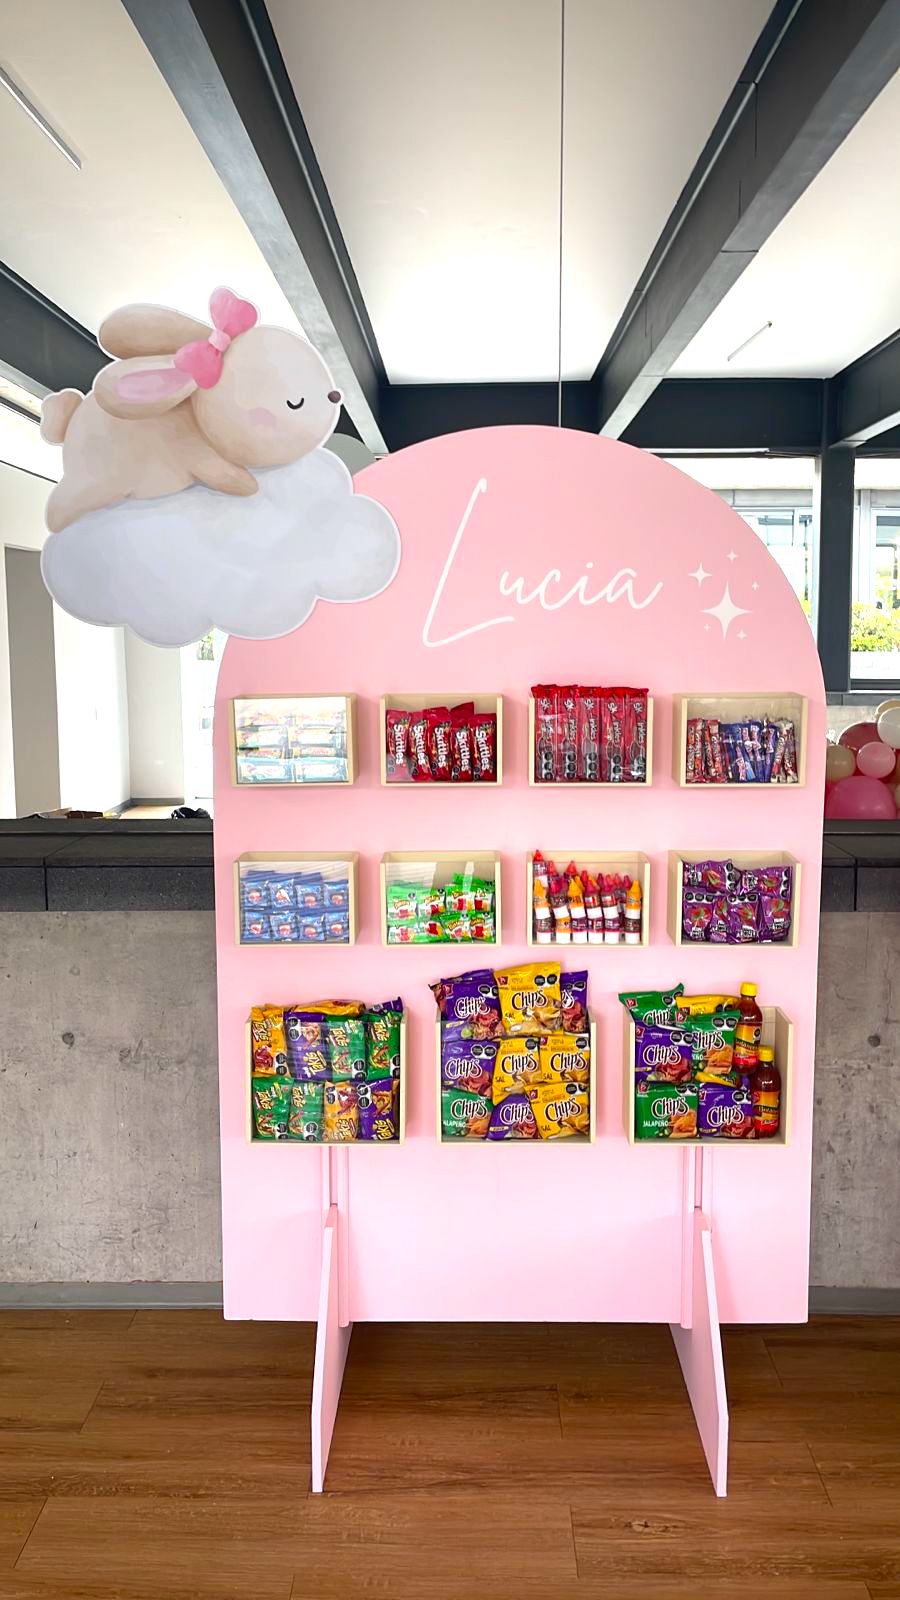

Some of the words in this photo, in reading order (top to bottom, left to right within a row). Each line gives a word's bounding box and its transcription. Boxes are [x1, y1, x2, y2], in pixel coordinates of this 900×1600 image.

[422, 477, 664, 647] Lucia
[394, 724, 406, 765] Skittles
[414, 725, 426, 766] Skittles
[434, 727, 448, 768] Skittles
[456, 731, 470, 772] Skittles
[476, 728, 490, 771] Skittles
[303, 1052, 326, 1076] Takis
[372, 1120, 394, 1140] Takis
